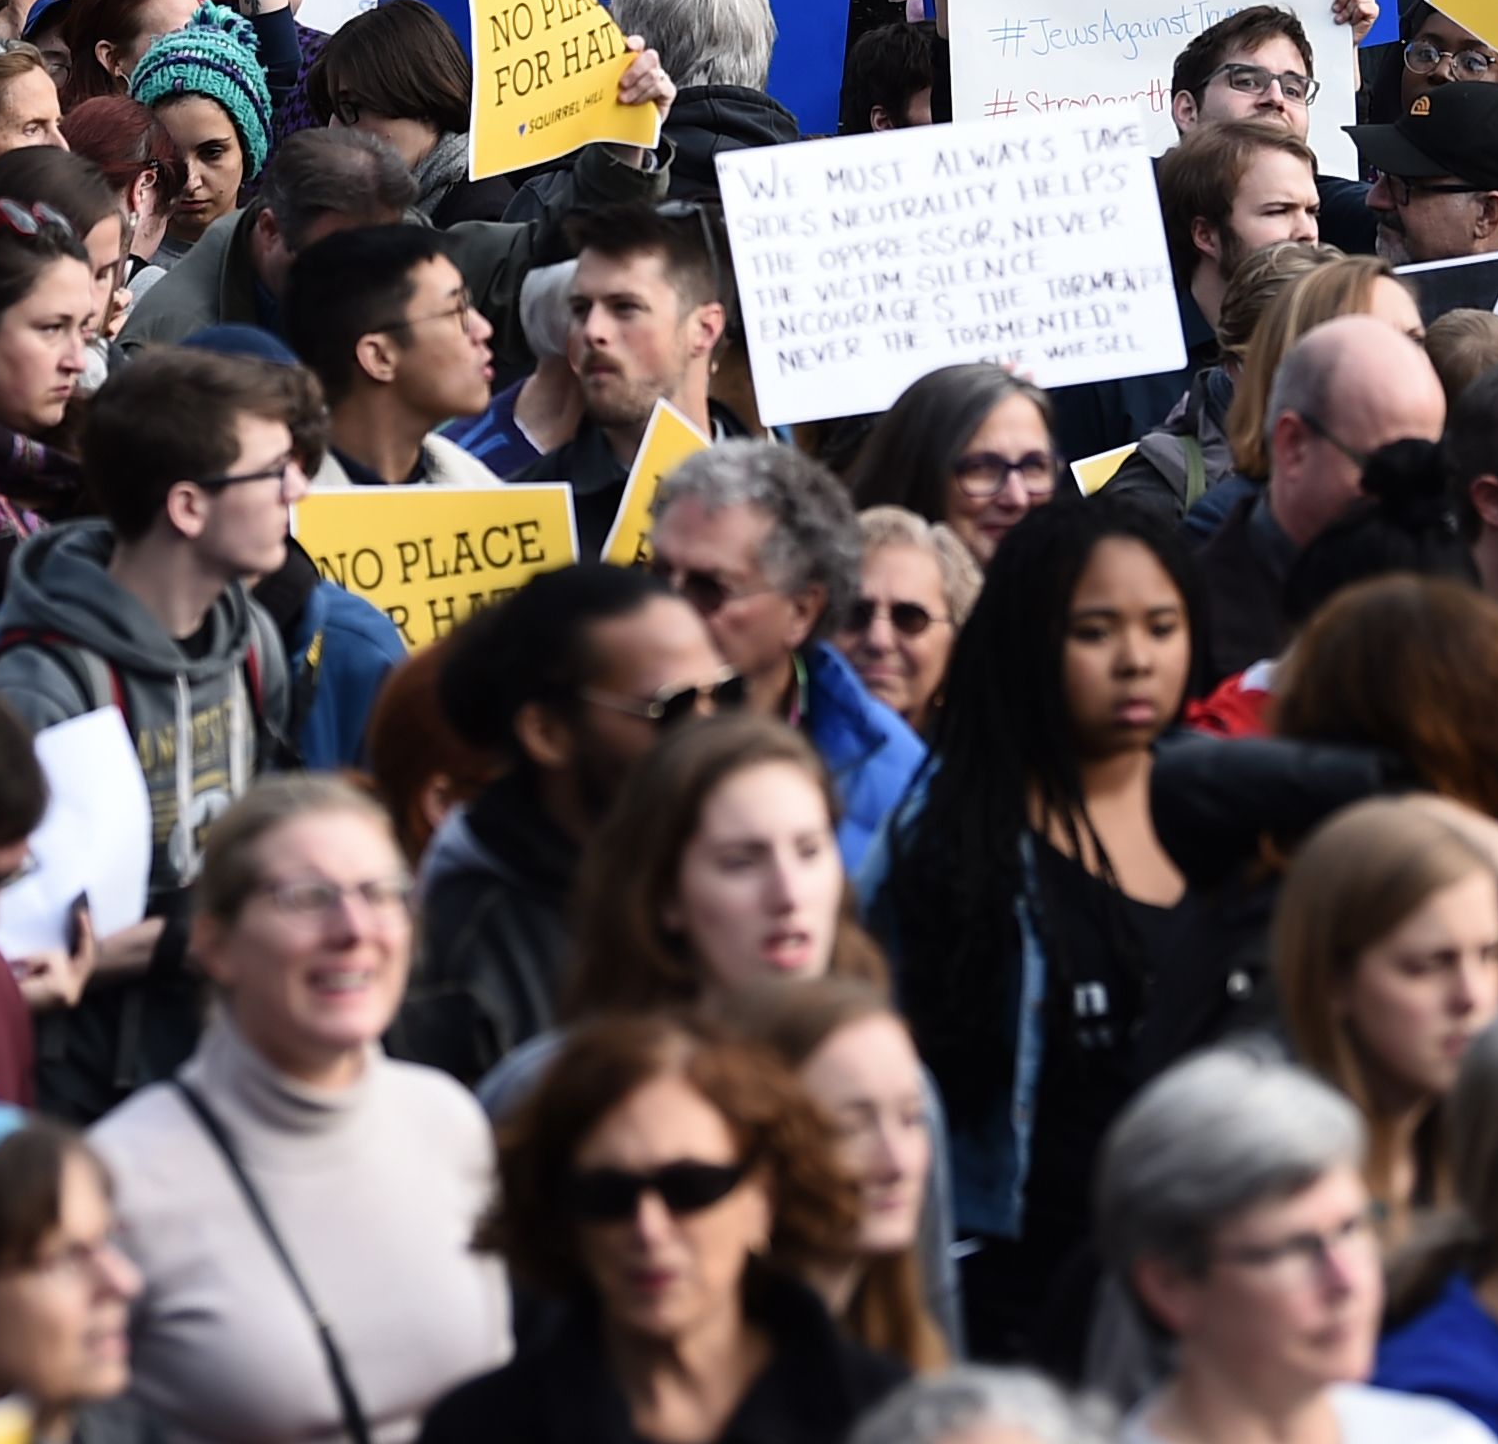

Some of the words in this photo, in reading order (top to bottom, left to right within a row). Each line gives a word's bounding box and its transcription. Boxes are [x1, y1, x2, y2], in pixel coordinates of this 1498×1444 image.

[489, 2, 534, 52] NO
[495, 50, 553, 106] FOR
[562, 21, 628, 78] HAT
[528, 101, 581, 134] SQUIRREL
[584, 89, 604, 109] HILL
[826, 159, 905, 194] MUST
[932, 136, 1058, 178] ALWAYS
[1080, 123, 1146, 151] TAKE
[738, 206, 819, 242] SIDES
[831, 180, 999, 231] NEUTRALITY
[1017, 163, 1128, 204] HELPS
[750, 250, 801, 277] THE
[1012, 206, 1124, 244] NEVER
[754, 282, 805, 309] THE
[815, 268, 905, 302] VICTIM
[917, 250, 1046, 292] SILENCE
[761, 291, 957, 344] ENCOURAGES
[977, 282, 1027, 316] THE
[778, 334, 862, 377] NEVER
[883, 329, 923, 351] THE
[1044, 333, 1143, 360] WIESEL
[315, 549, 383, 590] NO
[397, 520, 545, 583] PLACE
